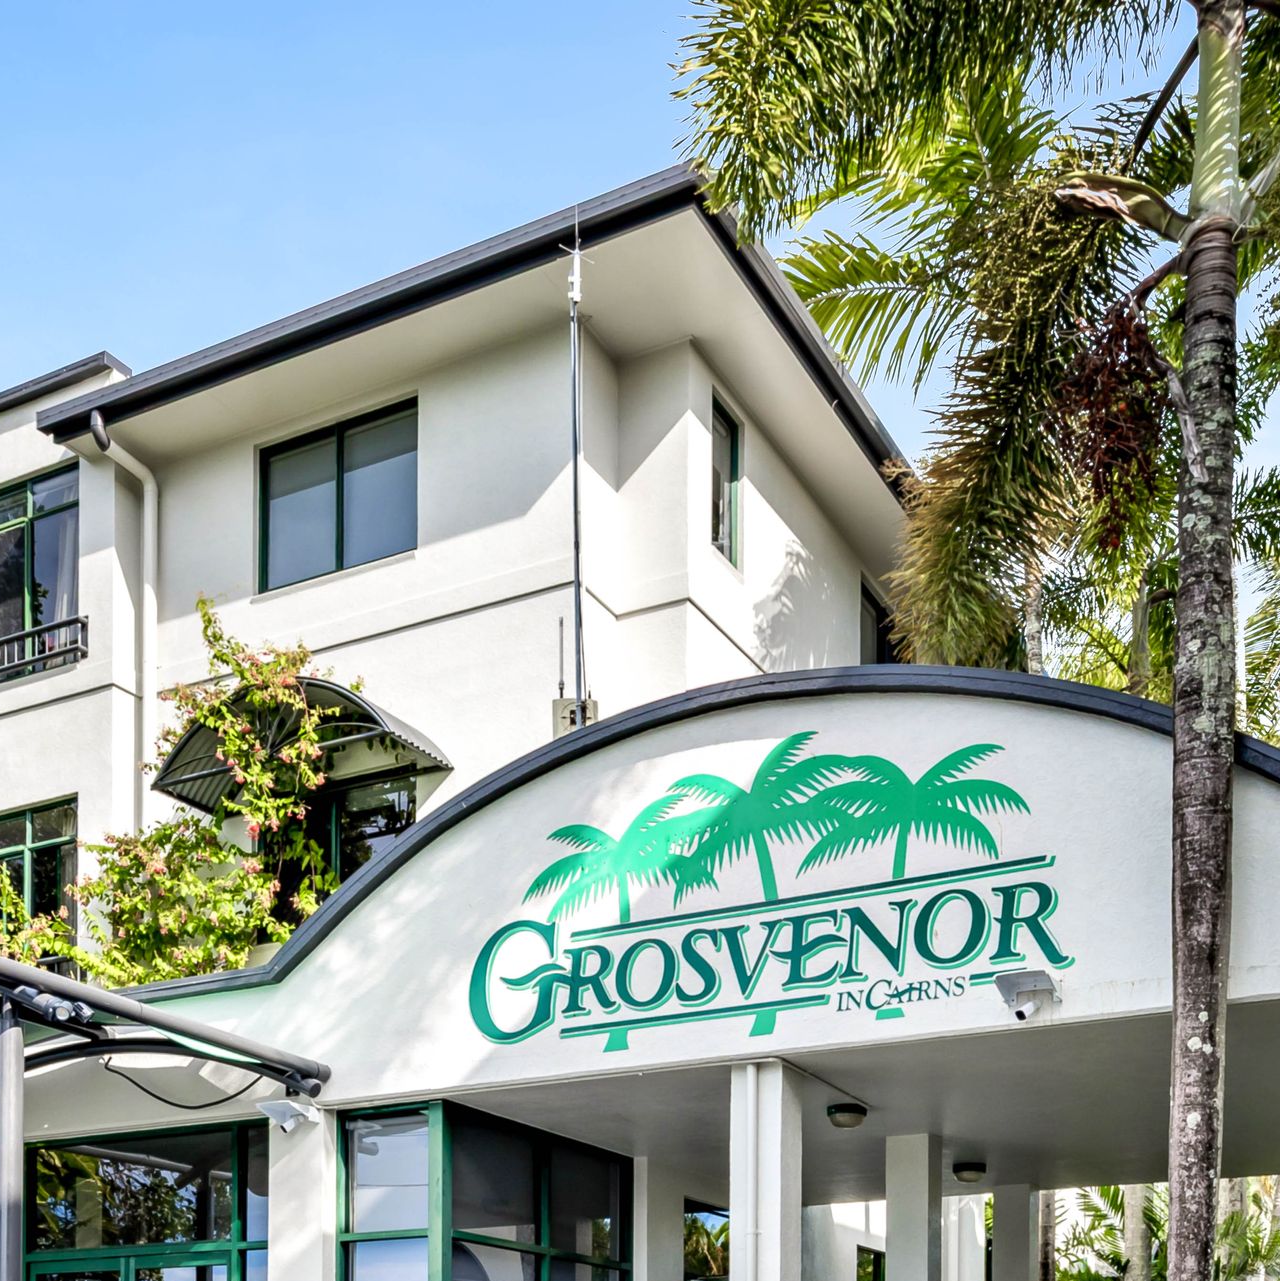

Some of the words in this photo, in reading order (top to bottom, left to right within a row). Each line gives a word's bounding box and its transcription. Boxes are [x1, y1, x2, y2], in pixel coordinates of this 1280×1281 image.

[469, 882, 1075, 1044] GROSVENOR
[836, 989, 864, 1012] IN
[865, 975, 966, 1011] CAIRNS
